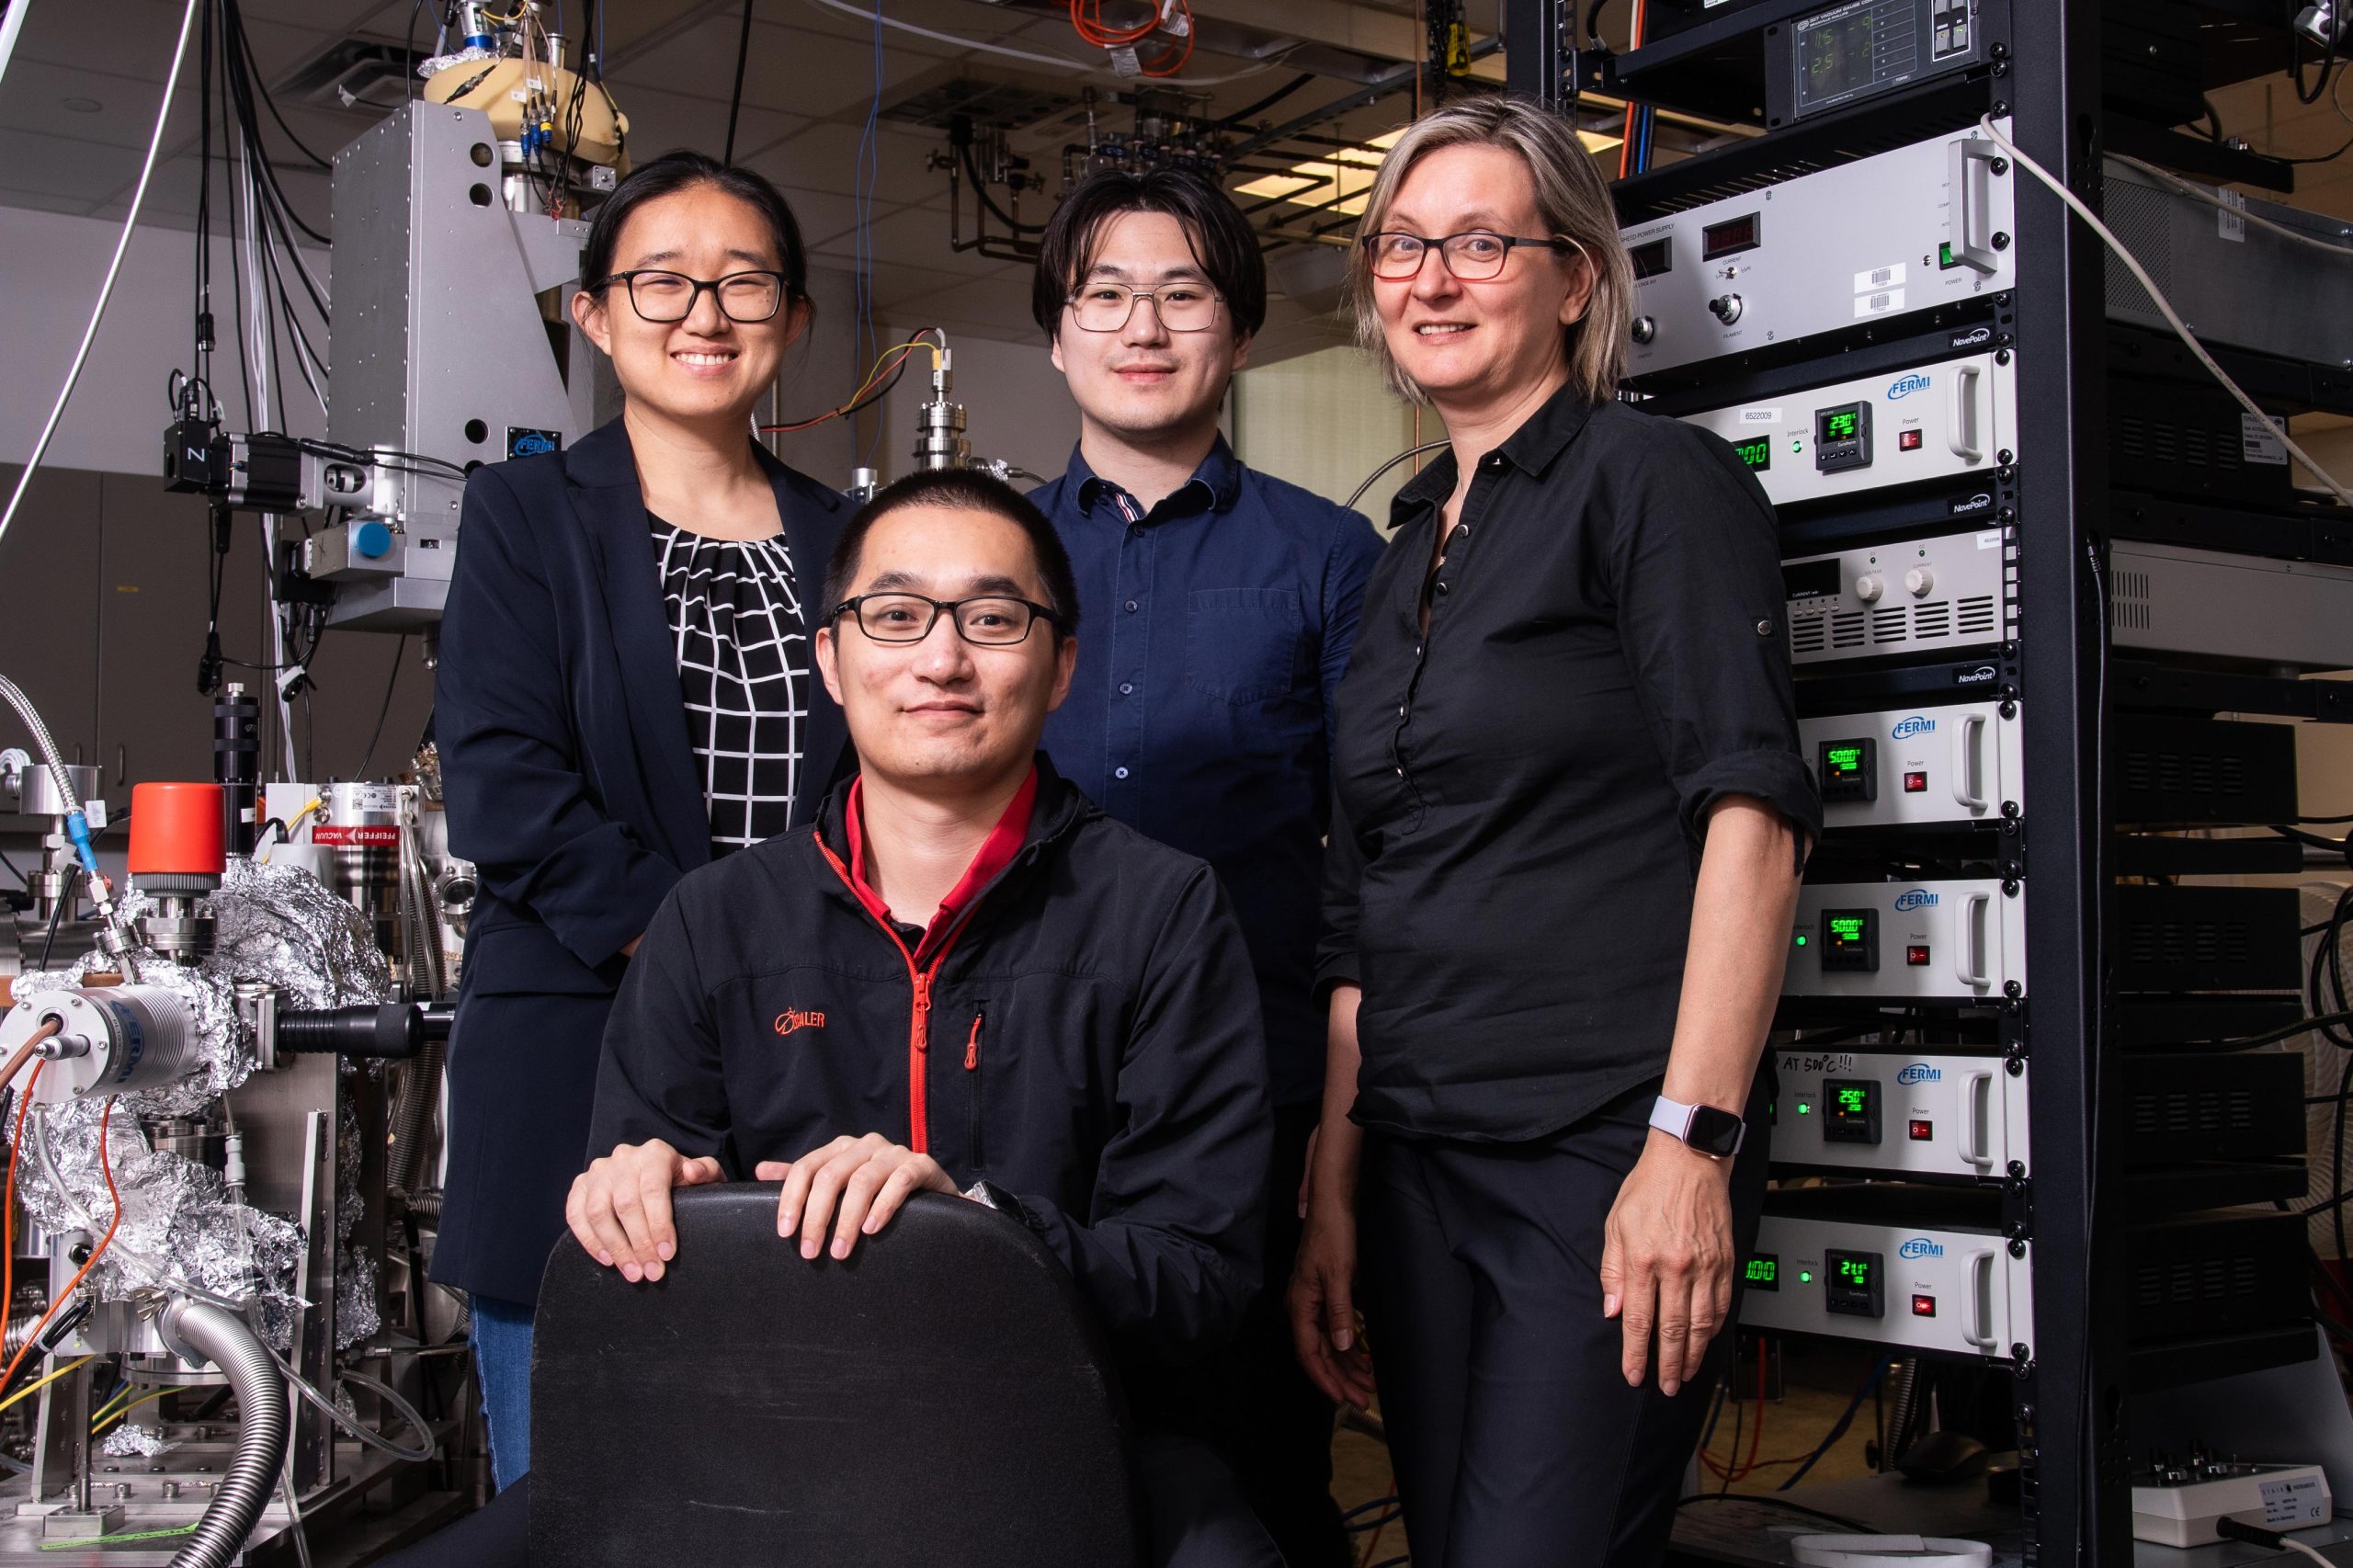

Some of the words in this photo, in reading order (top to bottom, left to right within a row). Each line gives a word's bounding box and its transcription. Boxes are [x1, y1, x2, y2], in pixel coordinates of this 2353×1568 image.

[1638, 228, 1656, 240] POWER
[1656, 222, 1676, 234] SUPPLY
[1945, 278, 1962, 287] POWER
[1952, 333, 1987, 347] NavePoint
[1893, 376, 1930, 394] FERMI
[1787, 427, 1809, 437] Interlock
[1954, 498, 1988, 514] NavePoint
[1958, 672, 1993, 684] NavePoint
[1897, 720, 1936, 733] FERMI
[1906, 759, 1925, 767] Power
[314, 831, 343, 840] VACUUM
[358, 831, 396, 840] PFEIFFER
[1899, 893, 1939, 905] FERMI
[1783, 1056, 1800, 1072] AT
[1903, 1068, 1941, 1080] FERMI
[1912, 1107, 1930, 1115] Power
[1904, 1241, 1944, 1256] FERMI
[1796, 1257, 1818, 1267] Interlock
[1914, 1281, 1932, 1290] Power
